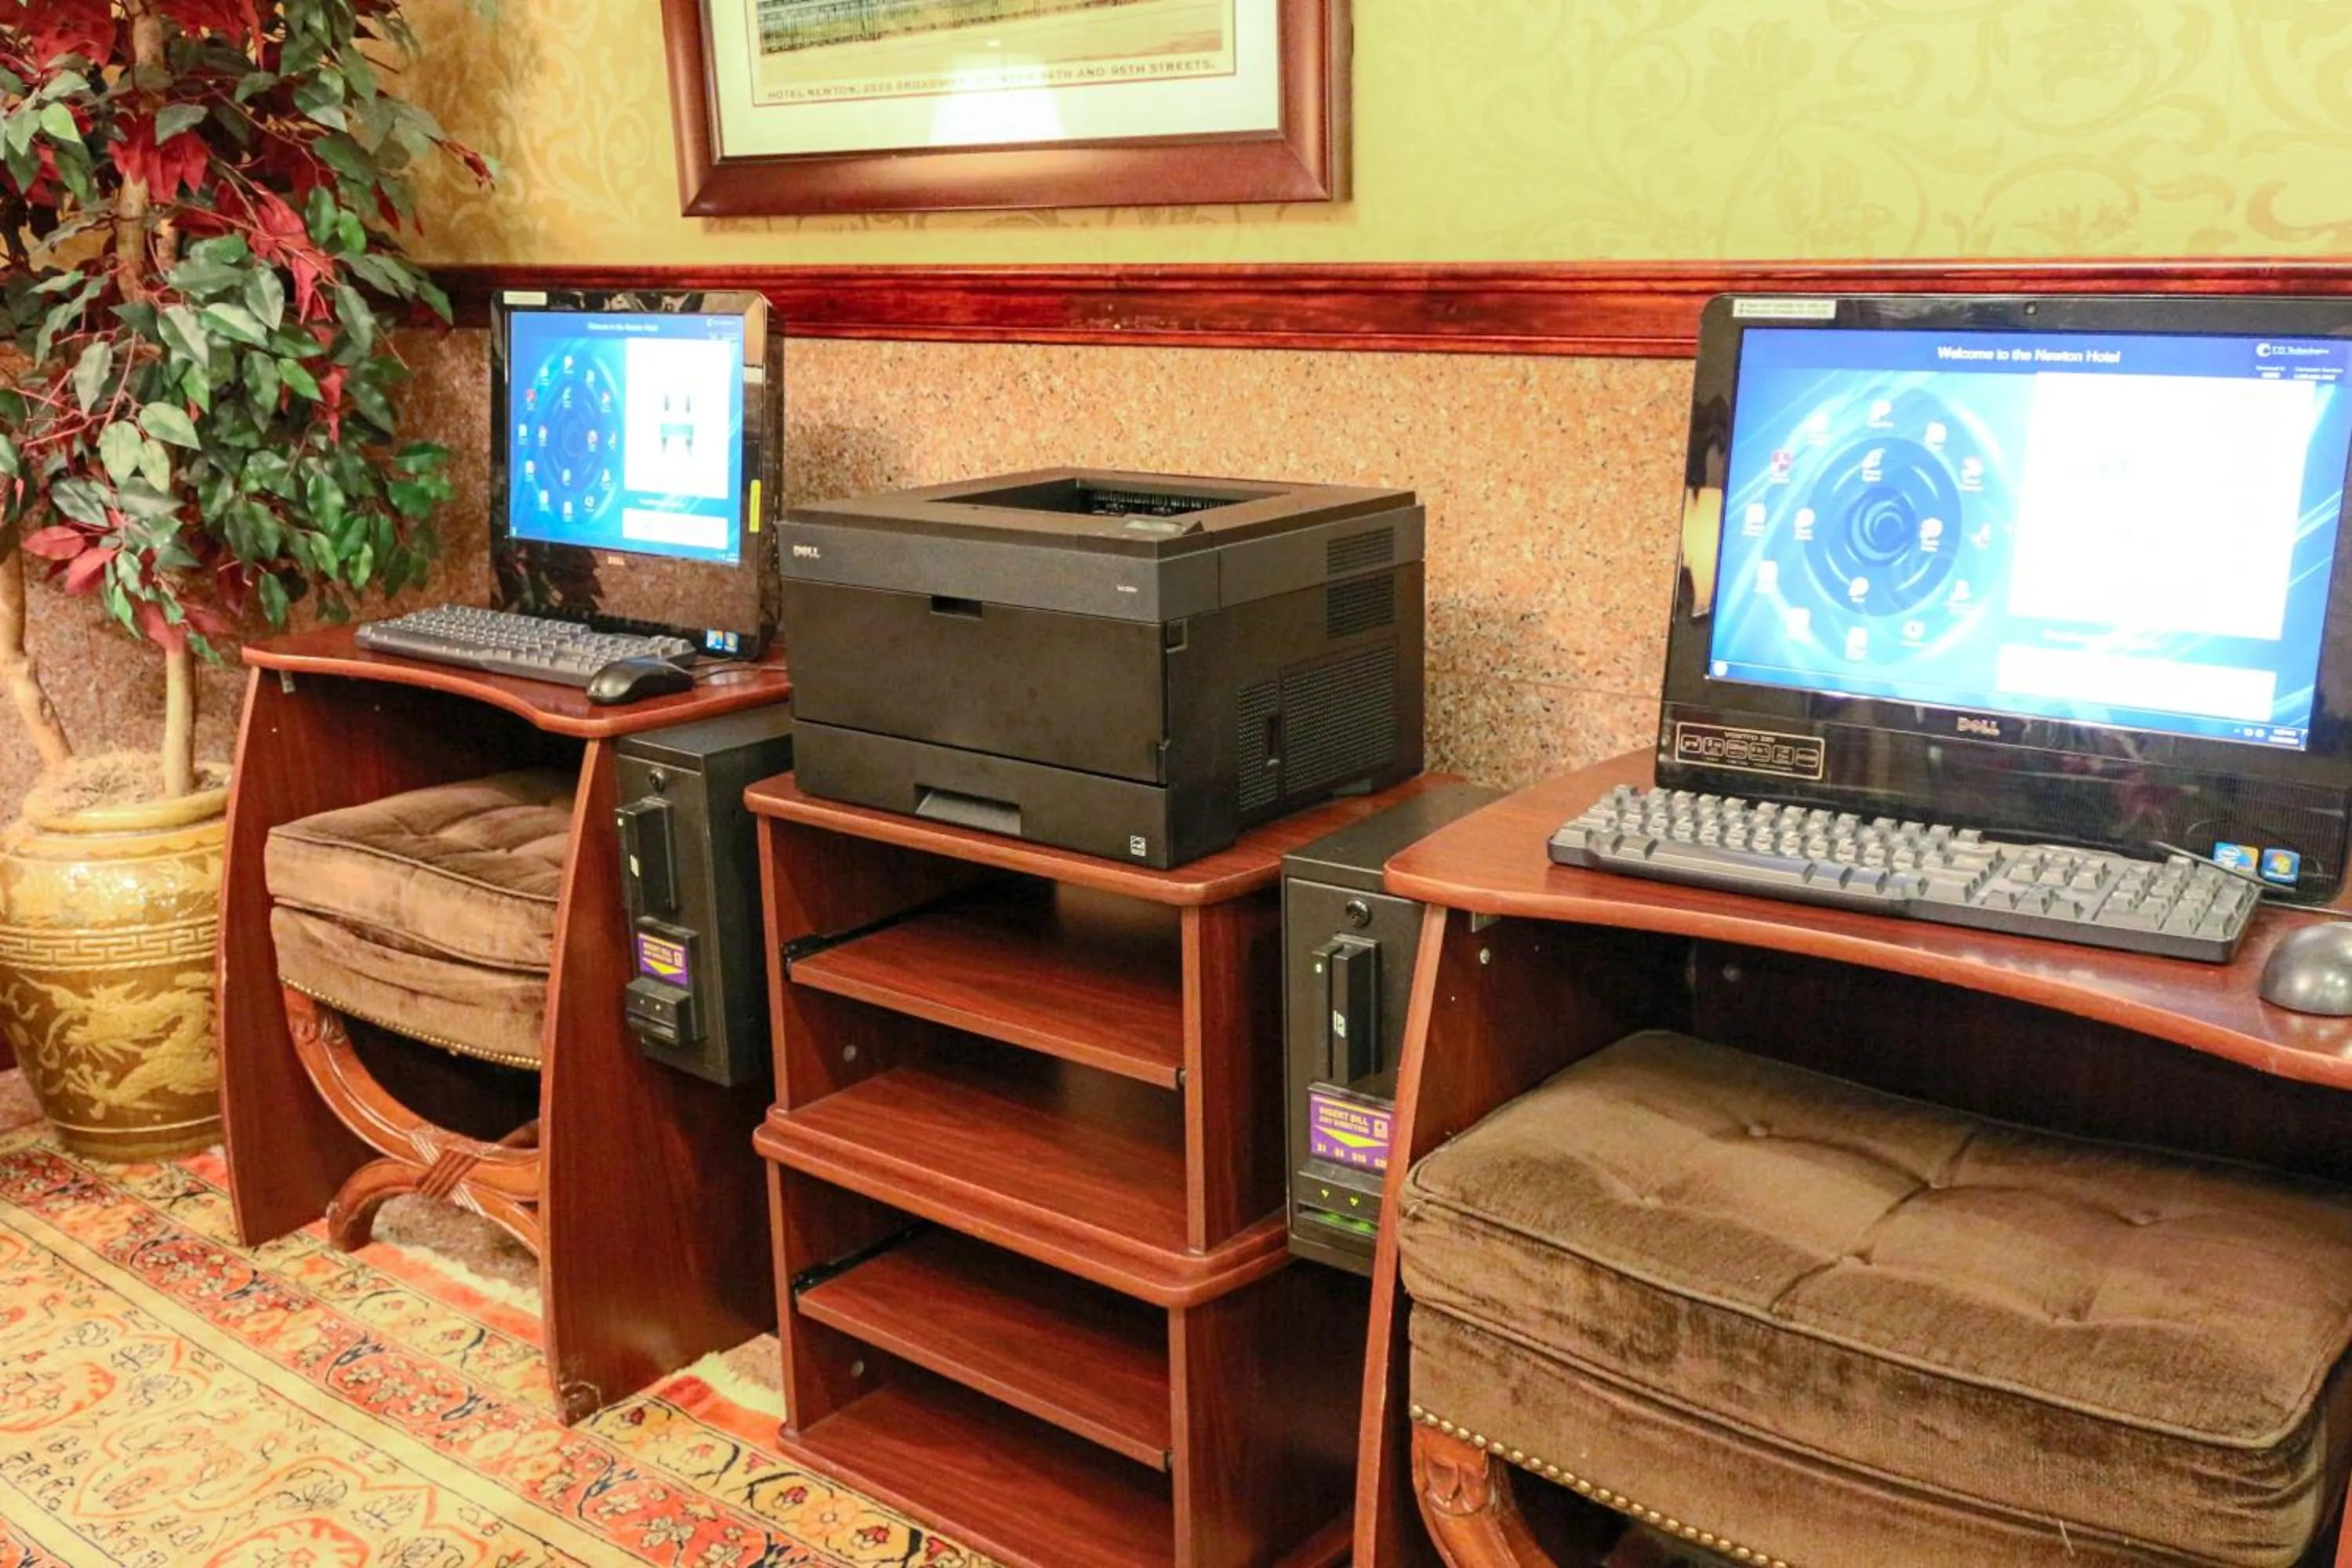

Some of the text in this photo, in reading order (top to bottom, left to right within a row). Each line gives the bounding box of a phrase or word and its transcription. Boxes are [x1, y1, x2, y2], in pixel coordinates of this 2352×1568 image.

[768, 89, 804, 100] HOTEL
[1076, 67, 1105, 78] AND
[1111, 64, 1145, 76] 95TH
[1937, 346, 2121, 364] Welcome to the Newton Hotel
[793, 545, 821, 559] DELL
[1957, 717, 2001, 735] DELL
[1319, 1105, 1370, 1127] INSERT BILL
